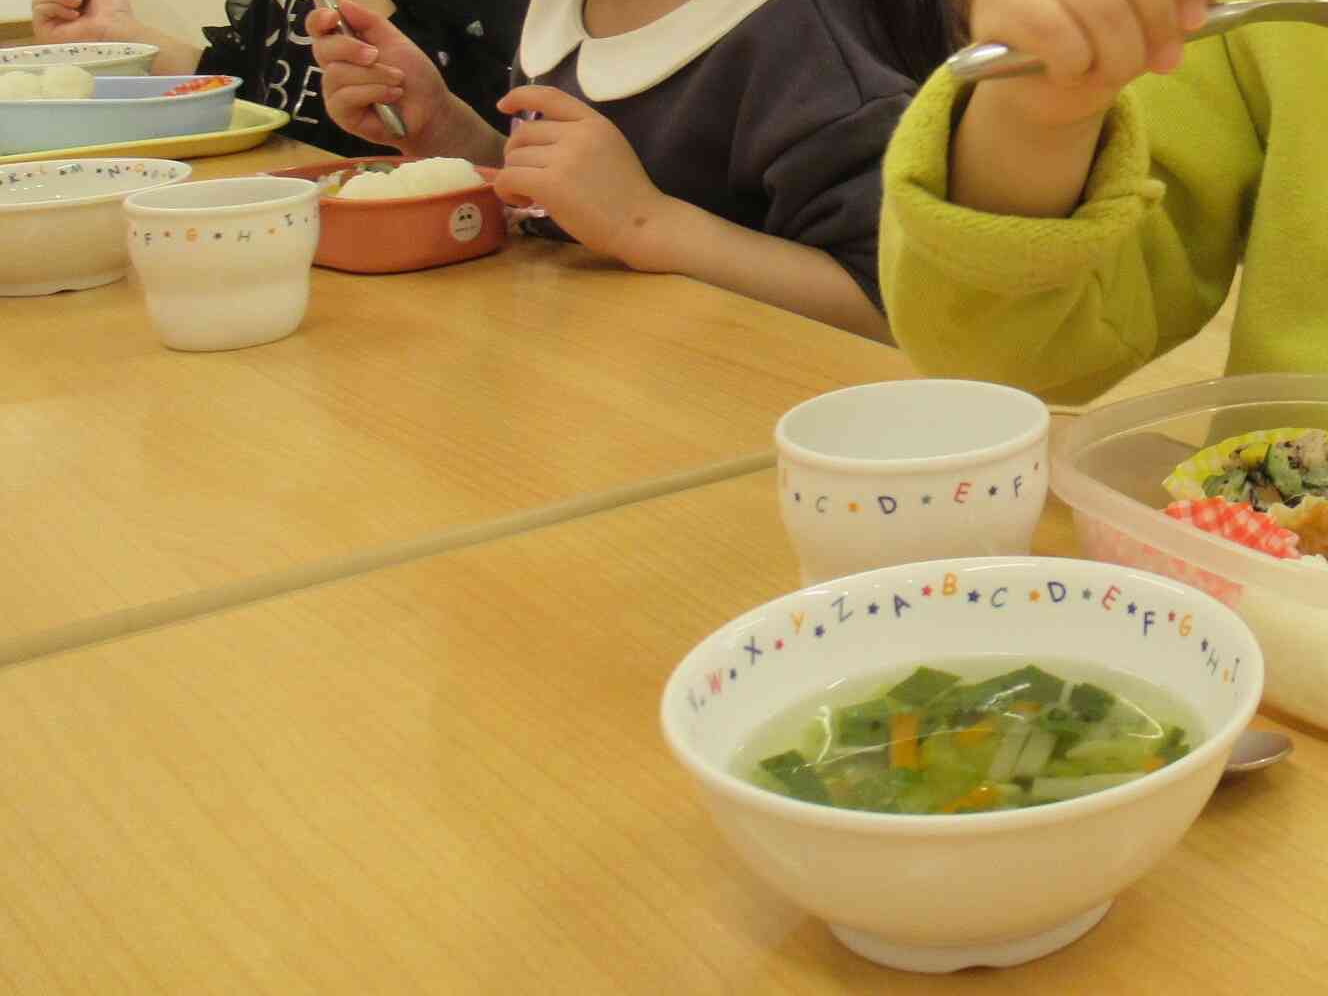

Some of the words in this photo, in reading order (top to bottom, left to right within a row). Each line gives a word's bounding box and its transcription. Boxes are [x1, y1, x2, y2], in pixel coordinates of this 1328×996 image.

[877, 495, 898, 515] D
[952, 481, 972, 504] E
[743, 635, 764, 665] X
[893, 593, 912, 618] A
[941, 572, 958, 596] B
[989, 586, 1009, 608] C
[1047, 580, 1067, 603] D
[1101, 585, 1122, 611] E
[1142, 610, 1156, 636] F
